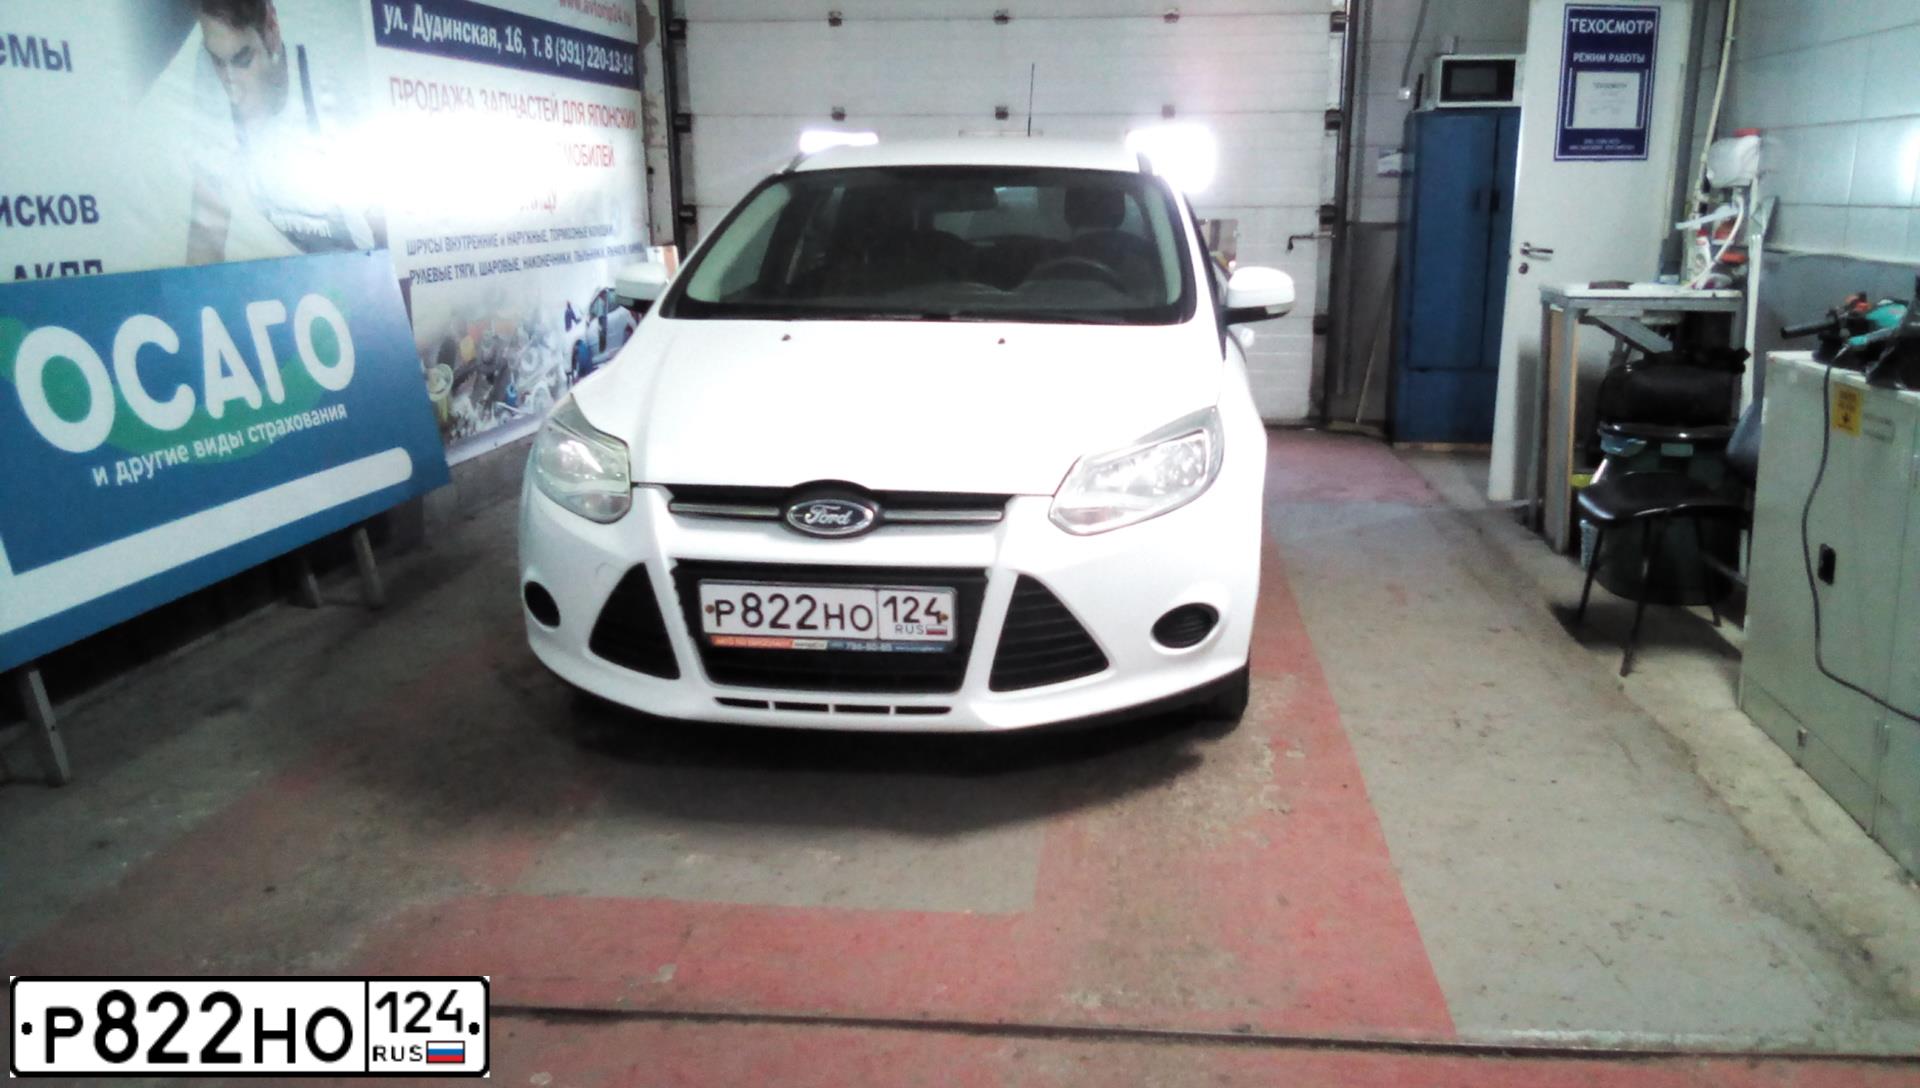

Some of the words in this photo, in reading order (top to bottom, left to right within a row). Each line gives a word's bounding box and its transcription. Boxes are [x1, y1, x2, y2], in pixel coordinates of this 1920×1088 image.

[1570, 18, 1653, 34] ТЕХОСМОТР
[383, 4, 408, 35] ул.
[412, 4, 501, 53] Дудинская,
[505, 25, 526, 58] 16,
[532, 35, 542, 57] т.
[545, 35, 553, 59] 8
[556, 37, 585, 71] (391)
[587, 44, 634, 75] 220-13-14
[1573, 52, 1606, 63] РЕЖИМ
[1608, 52, 1645, 64] РАБОТЫ
[389, 76, 475, 114] ПРОДАЖА
[480, 88, 559, 123] ЗАПЧАСТЕЙ
[563, 100, 585, 126] ДЛЯ
[406, 236, 443, 256] ШРУСЫ
[409, 264, 453, 284] РУЛЕВЫЕ
[454, 262, 478, 280] ТЯГИ,
[14, 292, 356, 453] ОСАГО
[92, 465, 109, 487] и
[116, 444, 190, 487] другие
[192, 431, 245, 458] виды
[248, 403, 348, 445] страхования
[804, 503, 853, 525] Ford
[714, 592, 874, 632] Р822НО
[883, 595, 943, 625] 124
[895, 625, 925, 636] RUS
